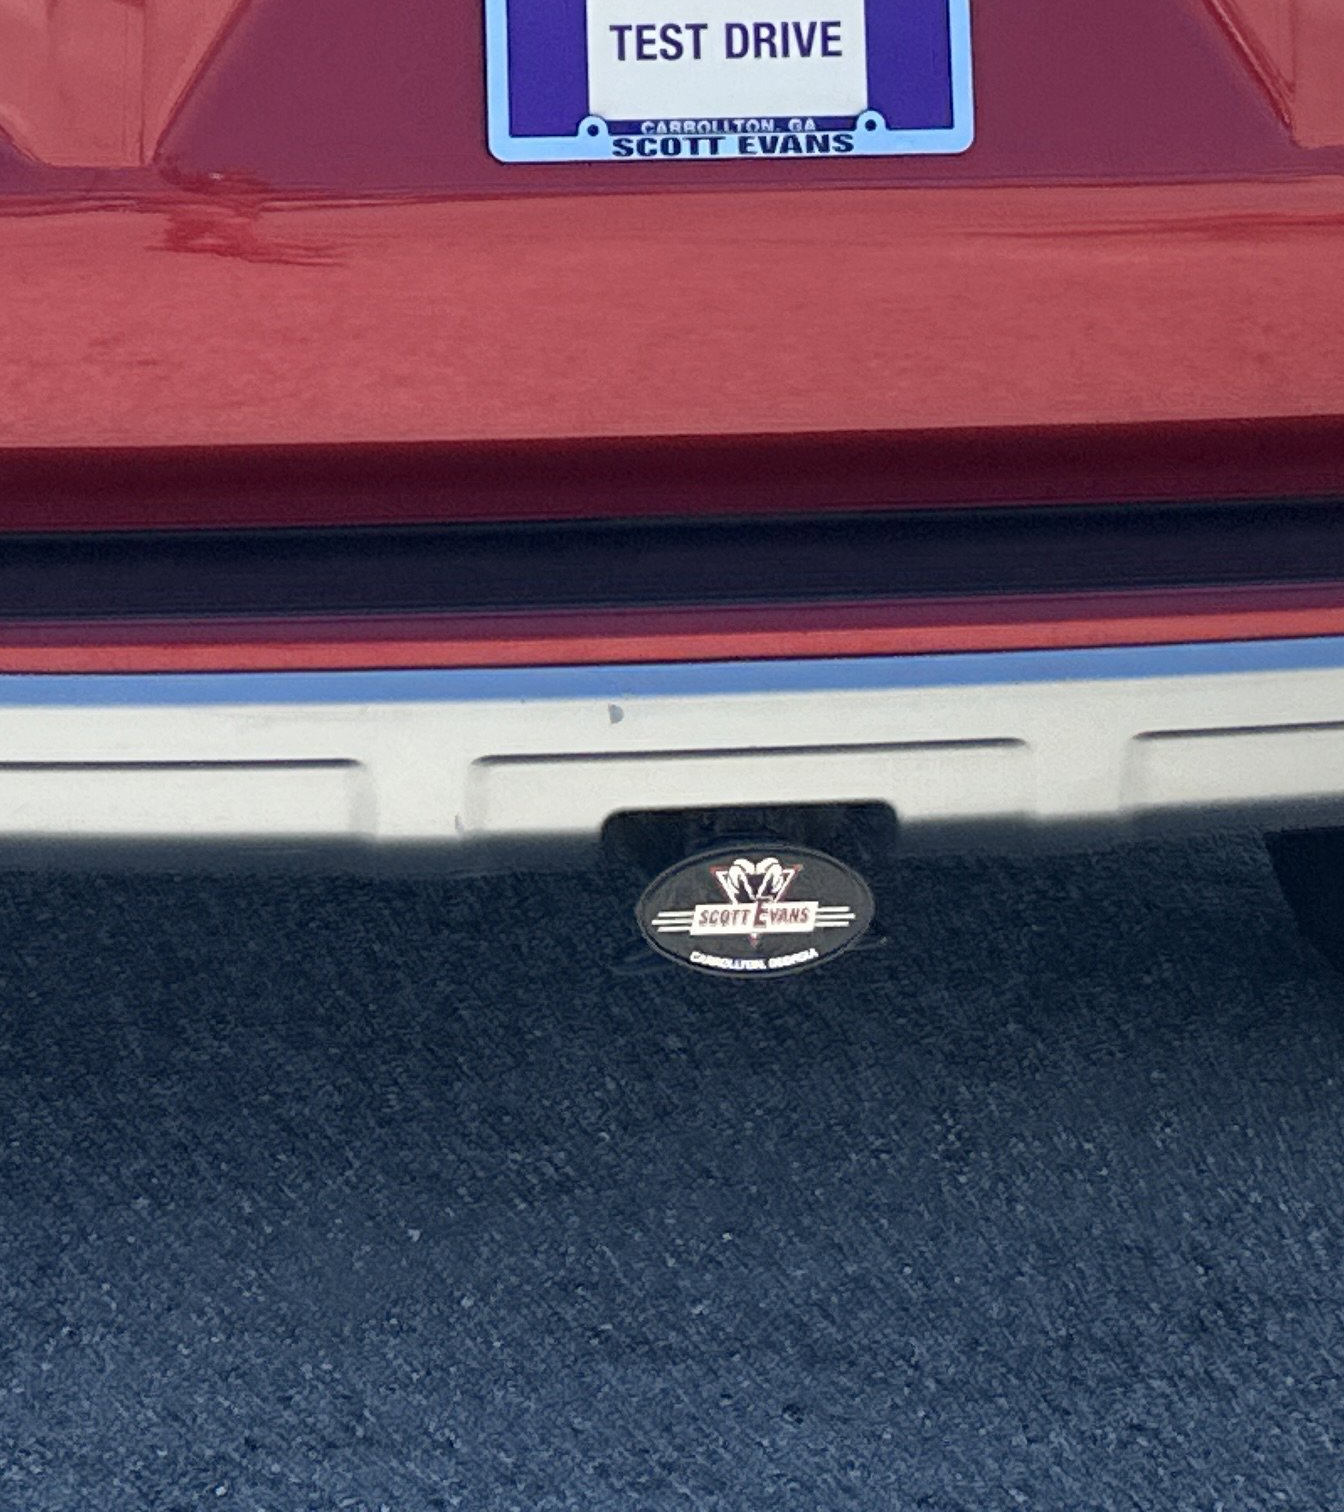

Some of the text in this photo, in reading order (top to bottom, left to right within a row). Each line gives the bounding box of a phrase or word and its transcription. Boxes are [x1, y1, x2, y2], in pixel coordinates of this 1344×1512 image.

[609, 21, 843, 61] TEST DRIVE
[788, 117, 816, 133] GA
[612, 133, 854, 157] SCOTT EVANS
[698, 899, 810, 928] SCOTT EVANS
